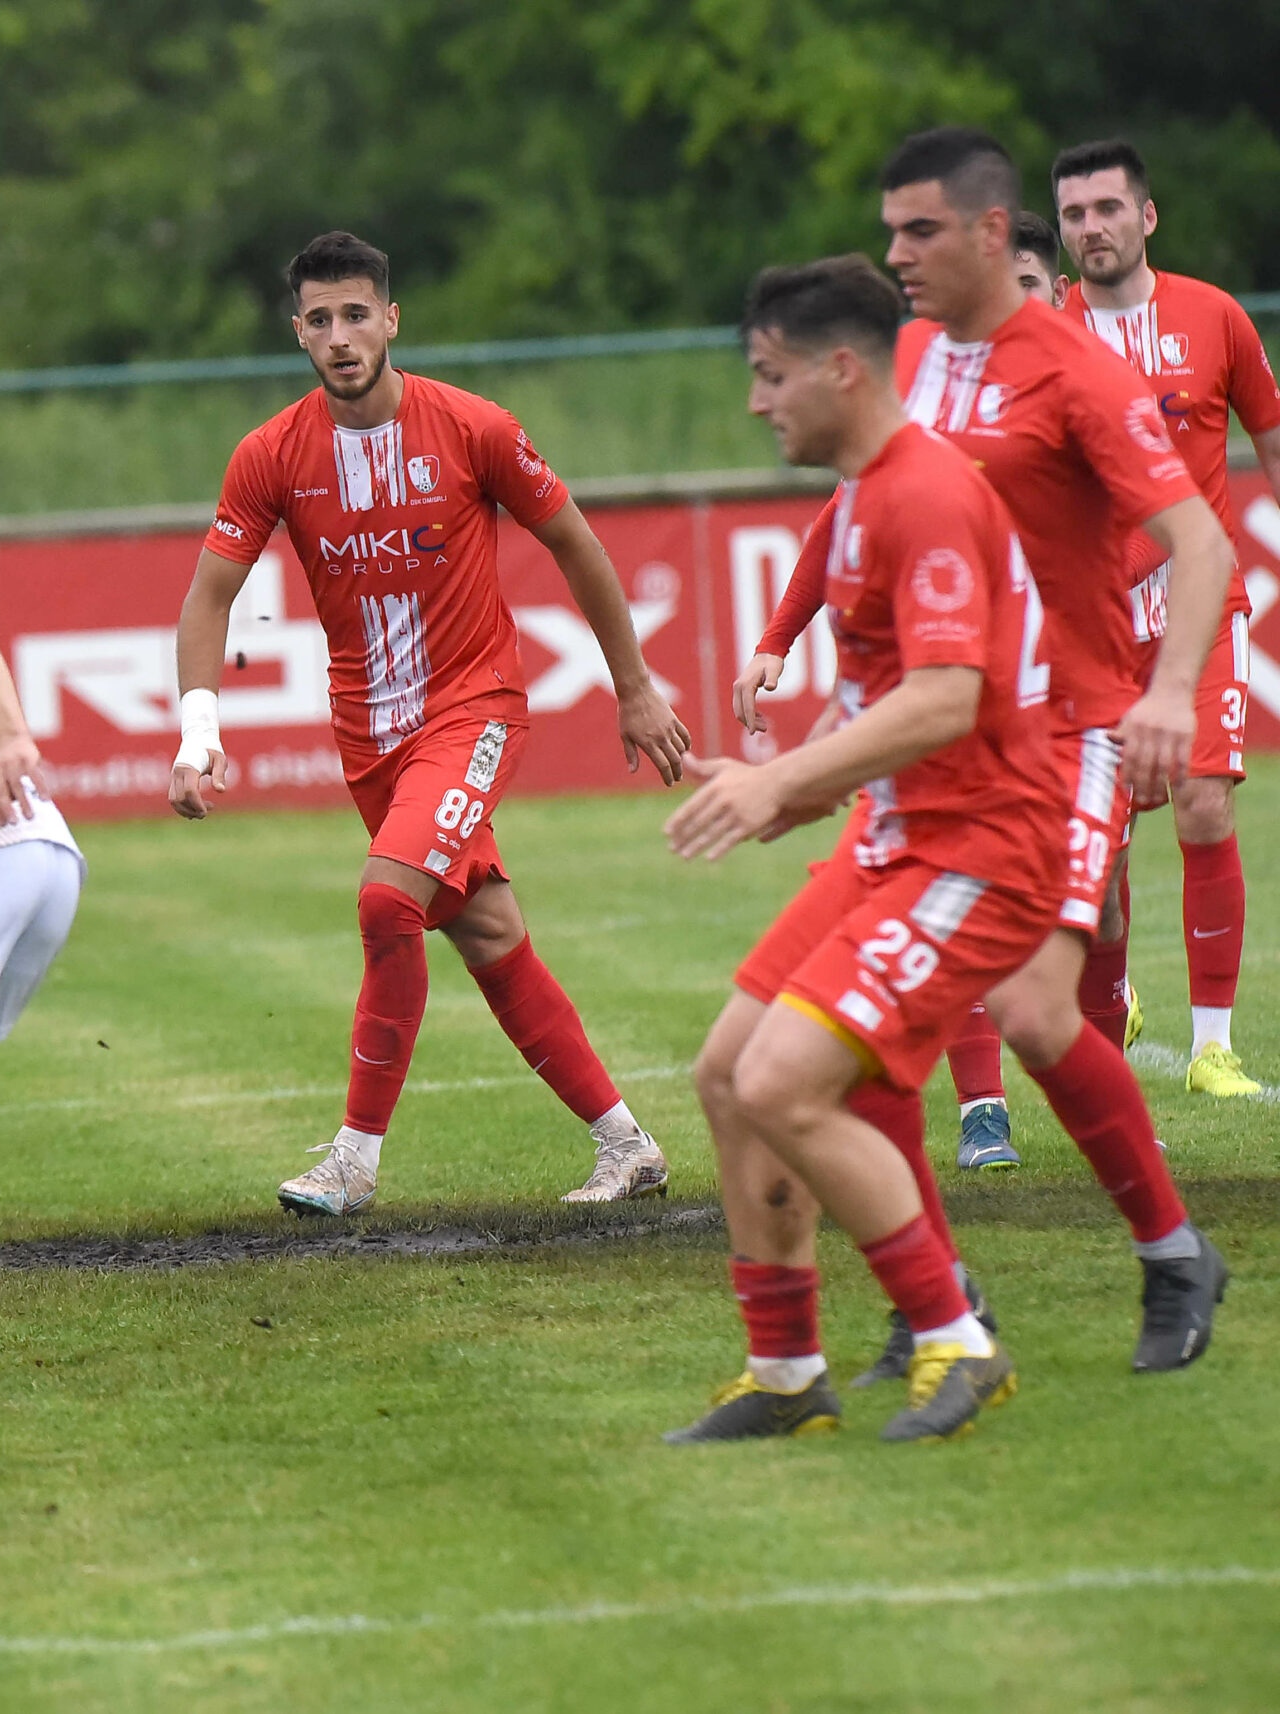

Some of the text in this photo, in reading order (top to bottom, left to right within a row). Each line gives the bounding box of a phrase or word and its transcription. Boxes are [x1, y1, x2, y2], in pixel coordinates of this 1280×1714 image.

[305, 487, 329, 497] alpas
[212, 517, 244, 540] MEX
[327, 554, 449, 576] GRUPA
[434, 787, 485, 840] 88
[857, 917, 940, 993] 29
